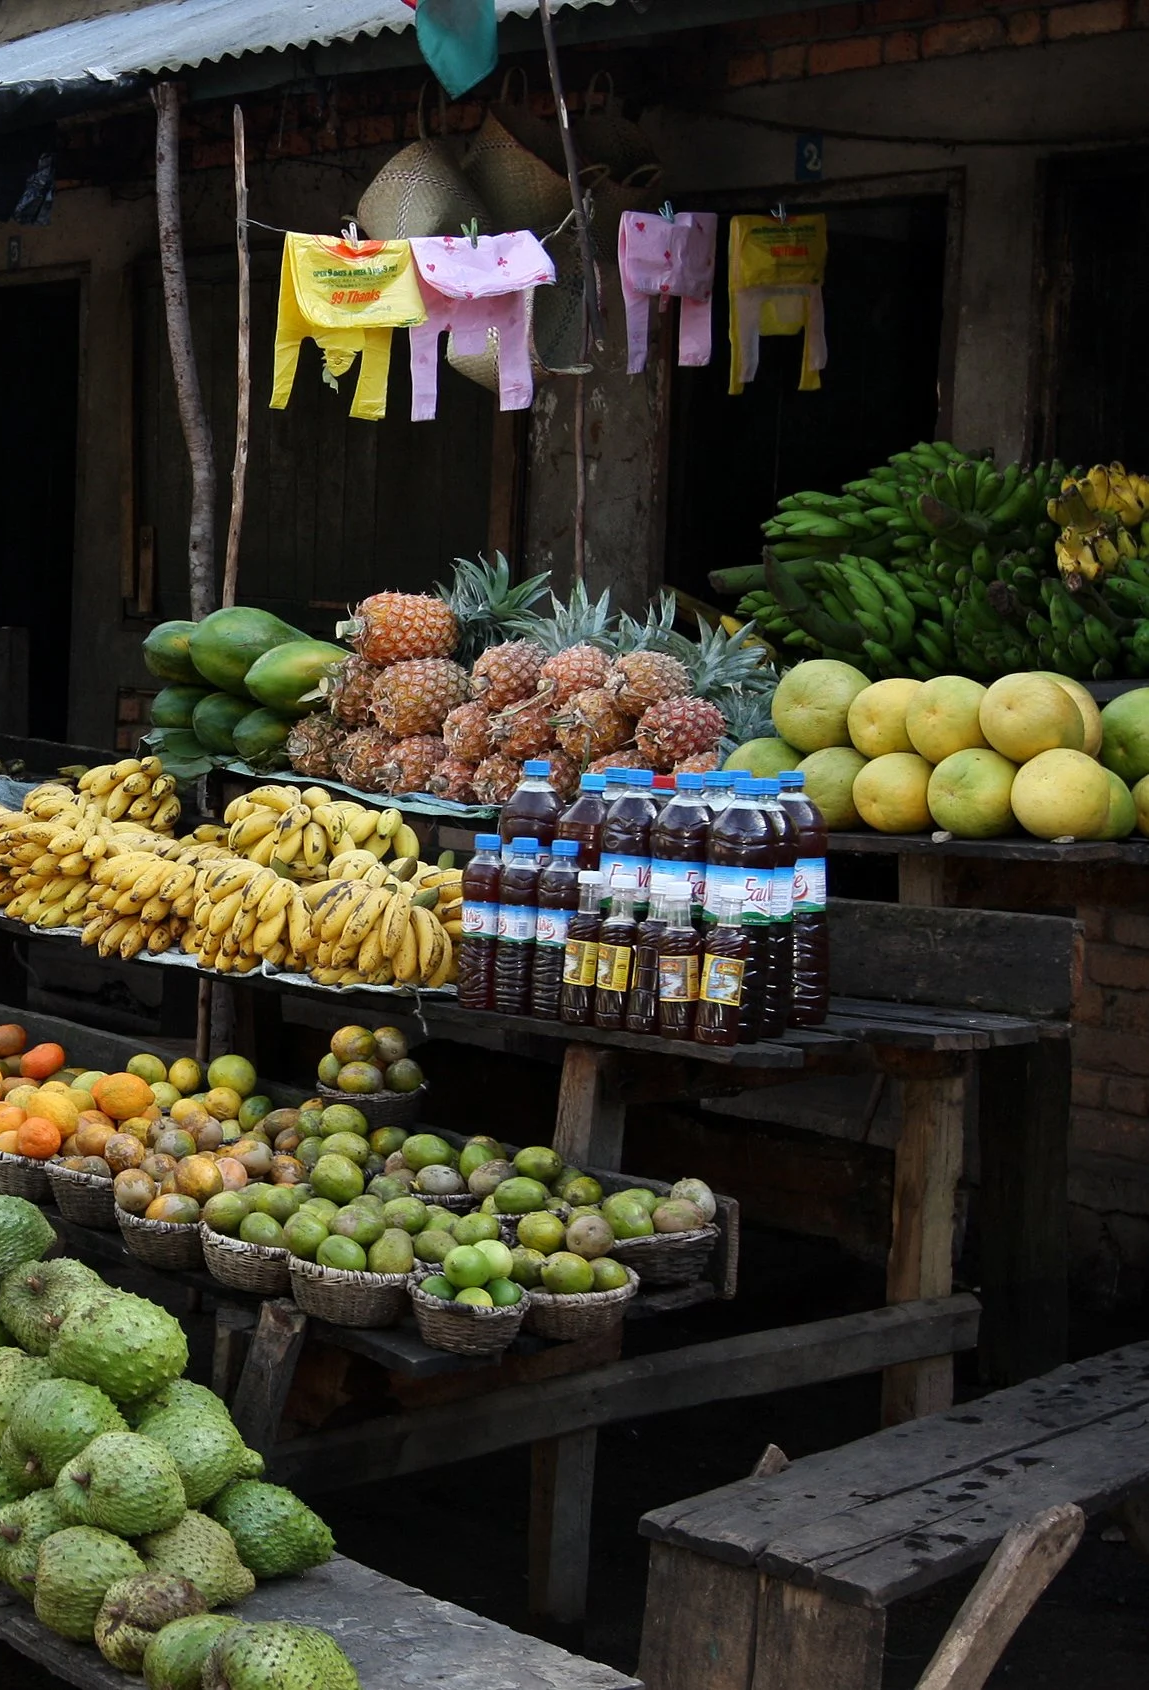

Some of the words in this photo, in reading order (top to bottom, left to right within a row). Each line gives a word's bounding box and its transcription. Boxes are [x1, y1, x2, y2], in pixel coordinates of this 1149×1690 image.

[803, 142, 822, 171] 2
[331, 291, 345, 305] 99
[347, 288, 381, 304] Thanks
